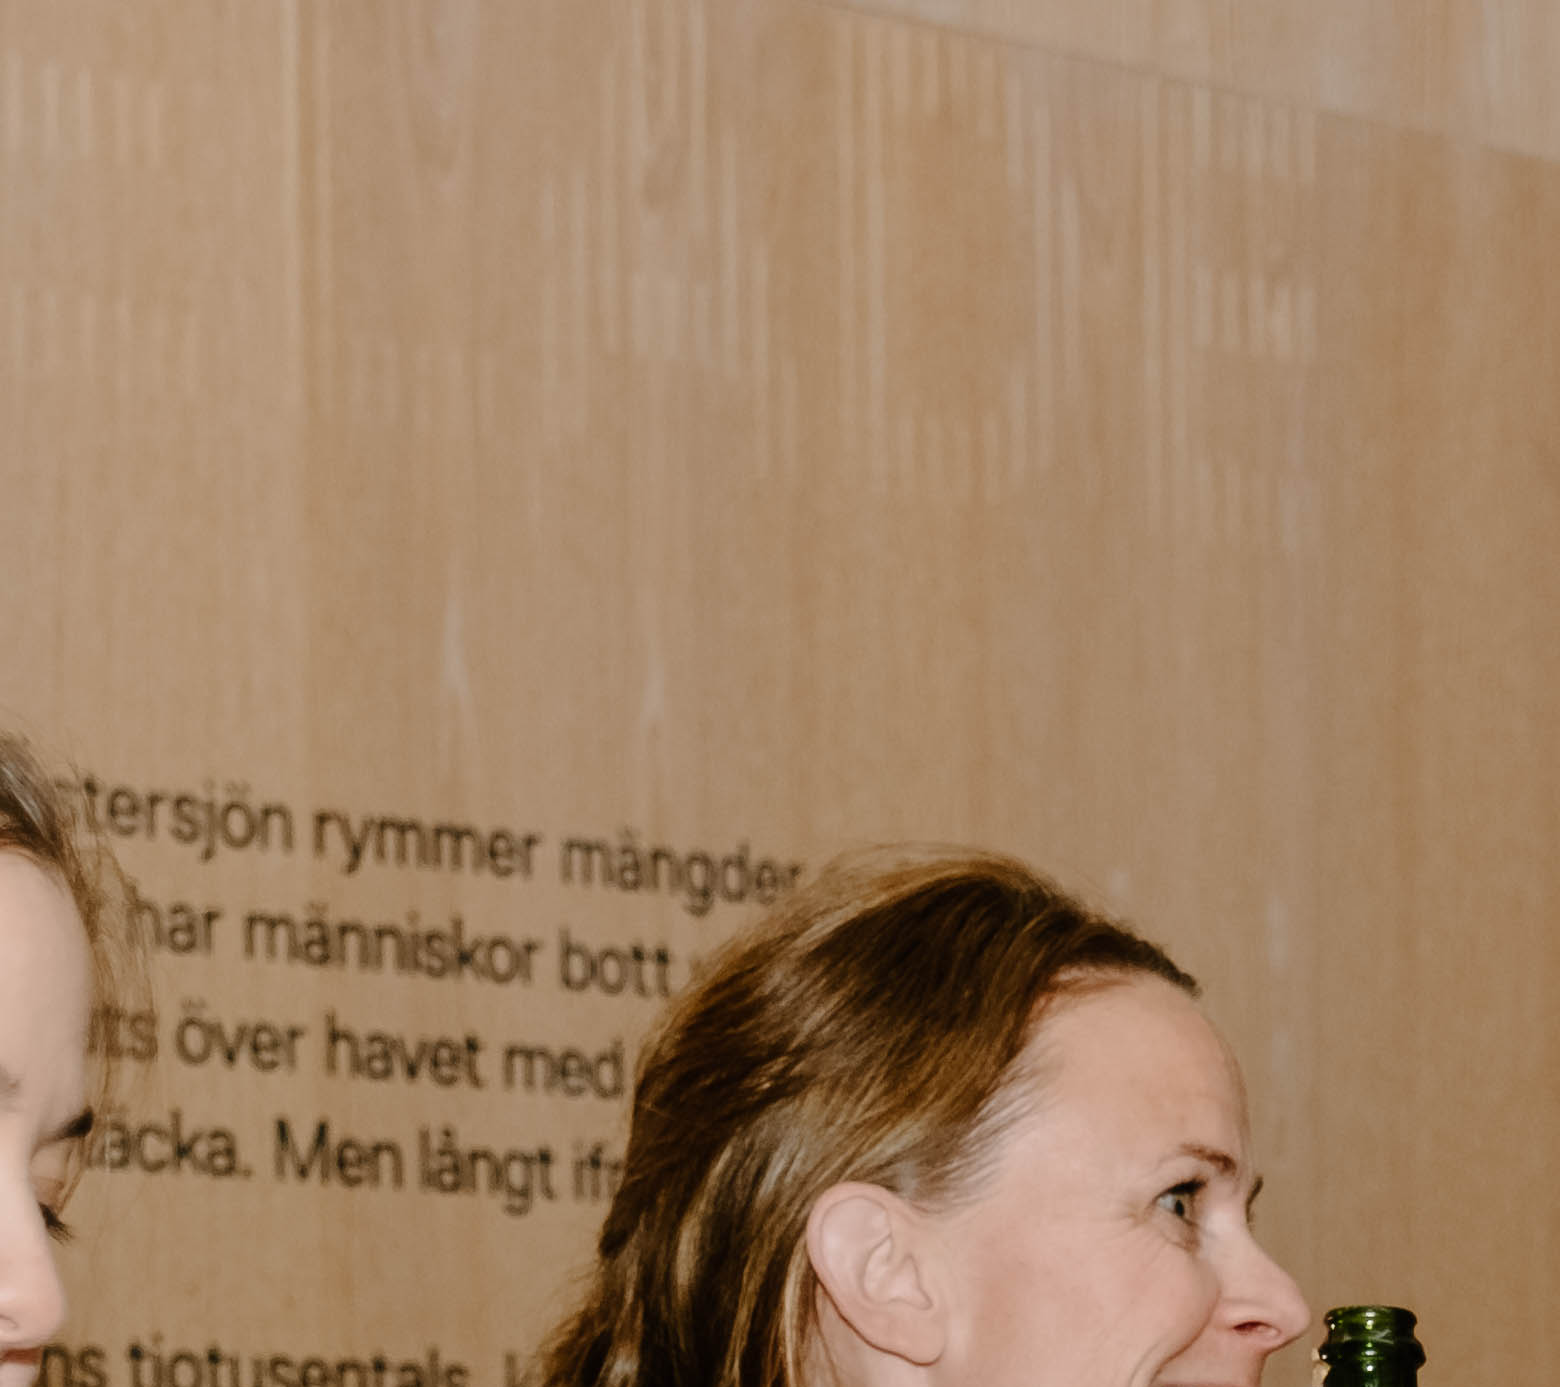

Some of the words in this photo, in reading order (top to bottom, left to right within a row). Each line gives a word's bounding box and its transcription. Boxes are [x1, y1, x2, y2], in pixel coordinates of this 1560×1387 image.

[312, 804, 540, 875] rymmer
[126, 882, 223, 956] har
[244, 902, 539, 985] människor
[559, 924, 672, 999] bott
[175, 997, 308, 1074] över
[324, 1009, 484, 1089] havet
[501, 1036, 626, 1101] med
[87, 1102, 254, 1181] äcka.
[272, 1112, 405, 1191] Men
[416, 1123, 556, 1219] långt
